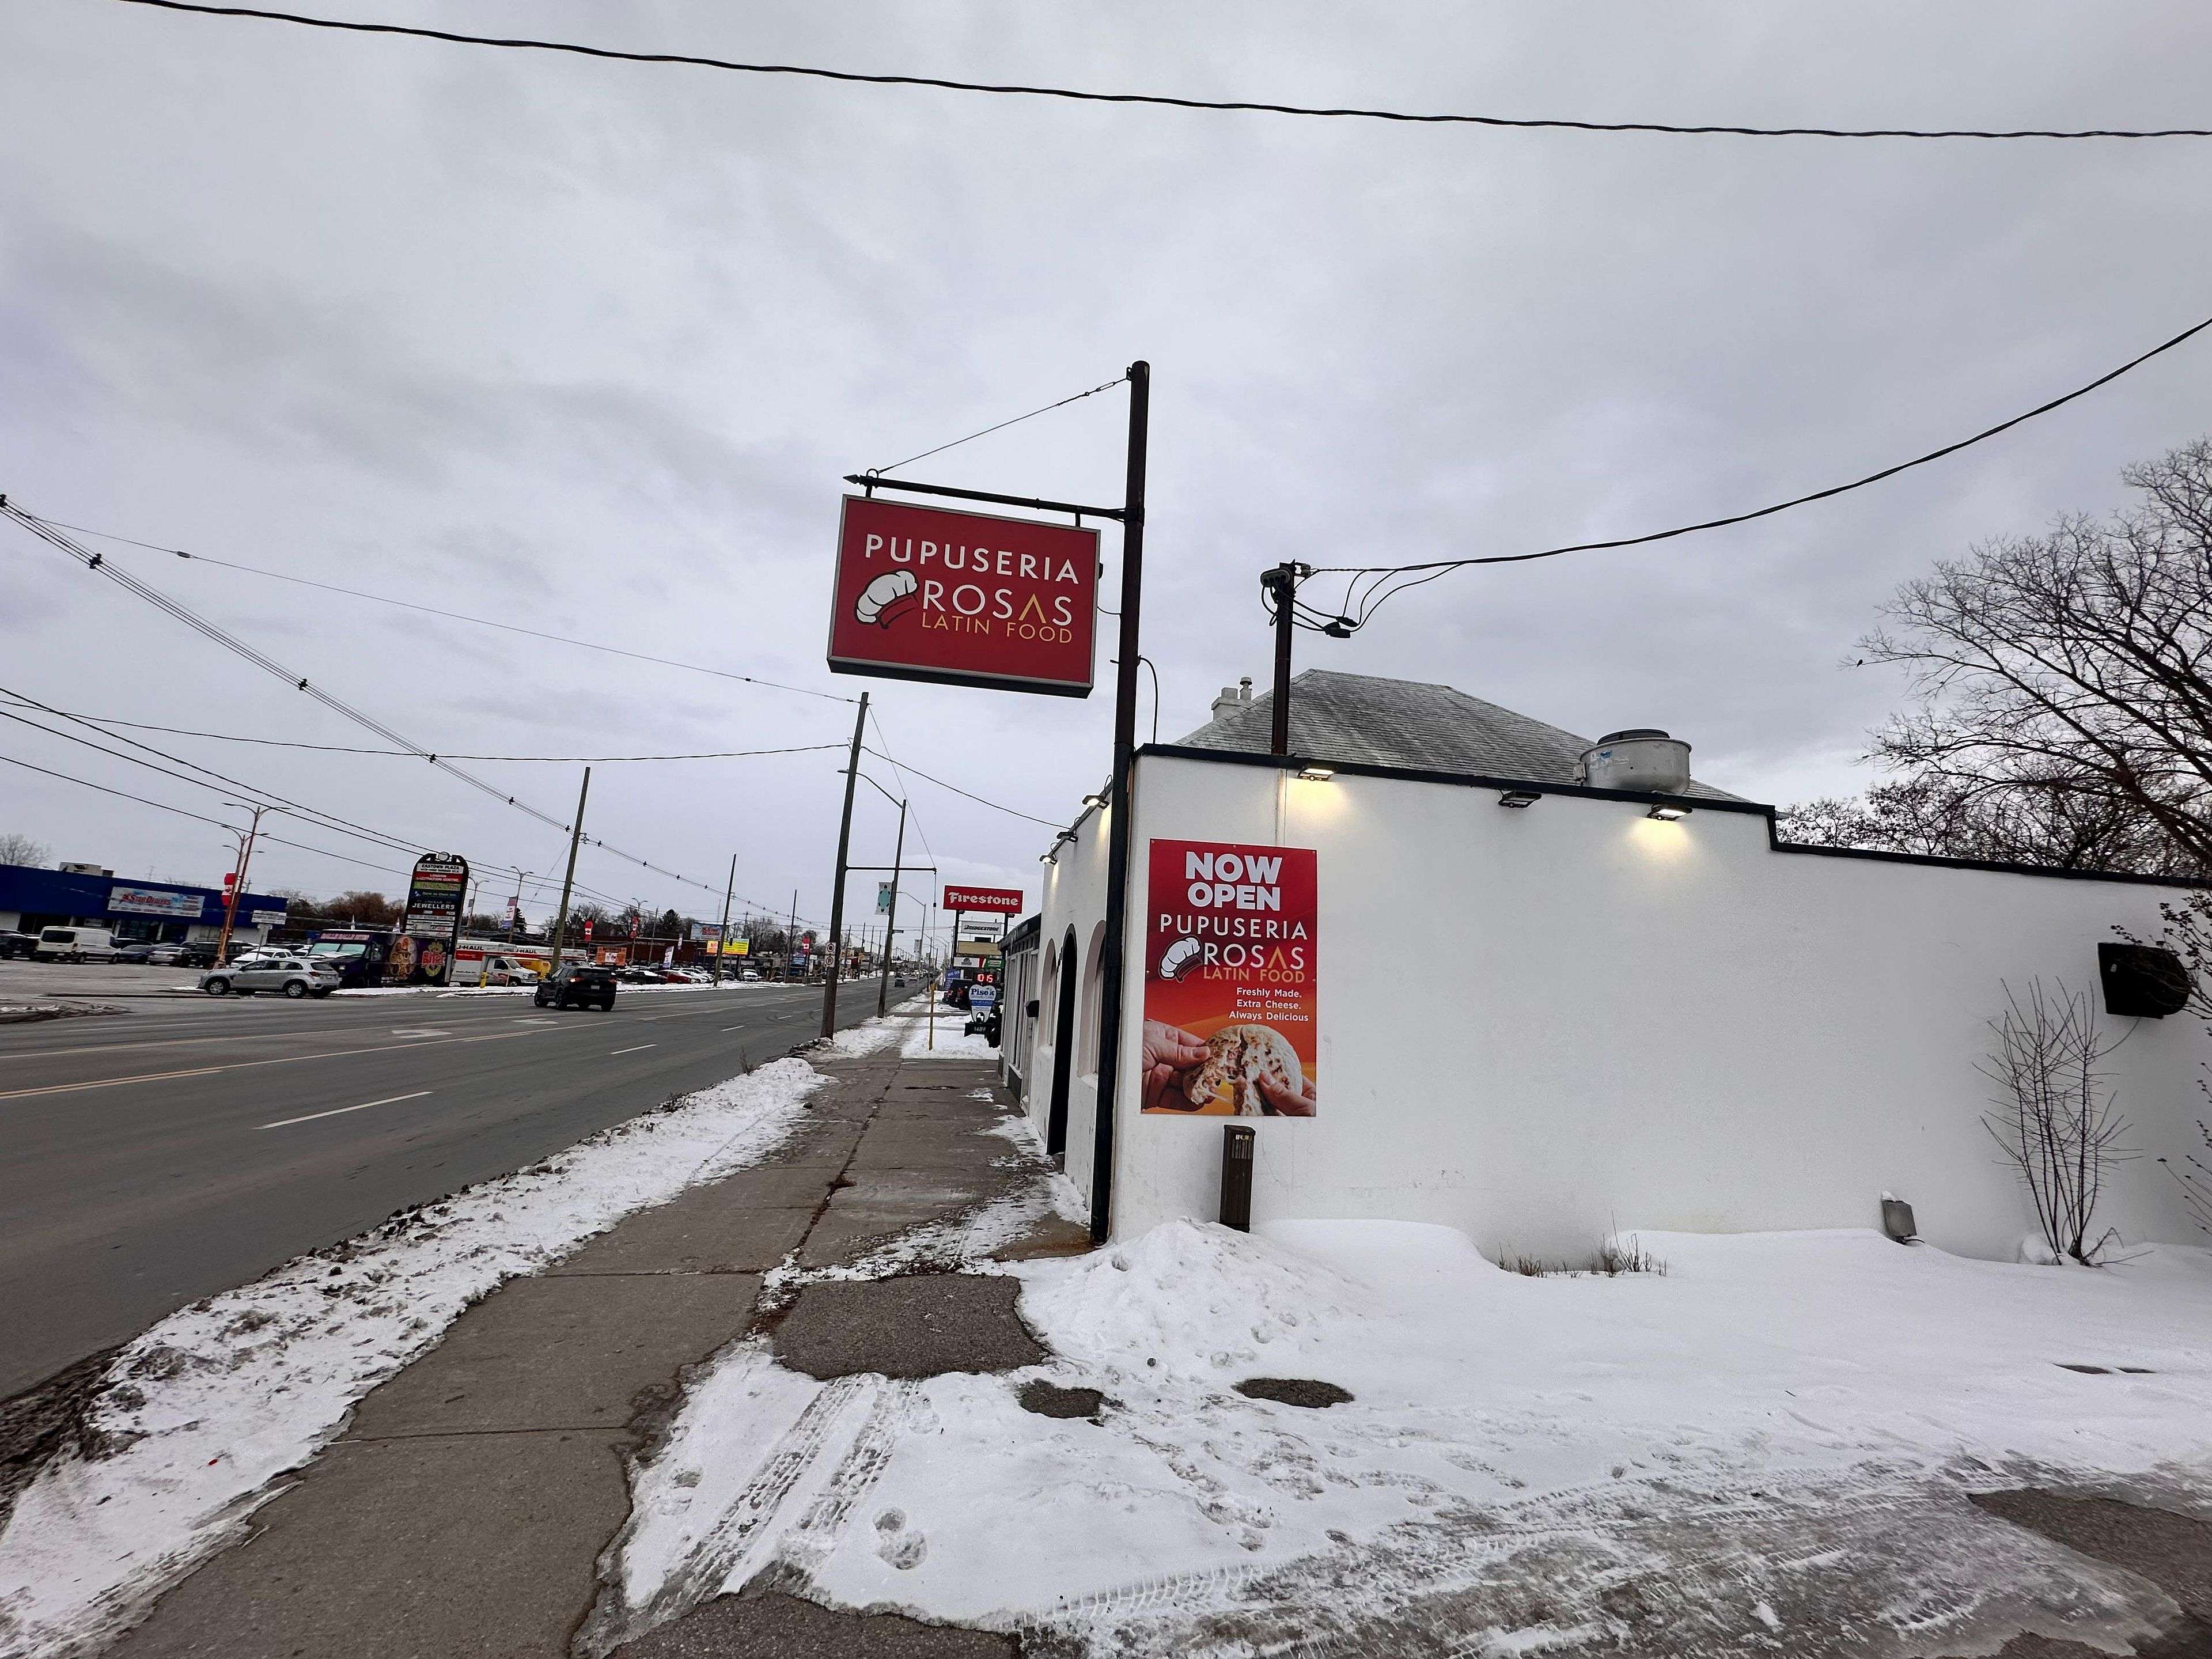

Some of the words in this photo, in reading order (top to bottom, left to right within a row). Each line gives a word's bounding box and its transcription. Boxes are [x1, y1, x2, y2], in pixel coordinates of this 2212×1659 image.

[865, 533, 1078, 584] PUPUSERIA
[922, 612, 990, 634] LATIN
[1006, 622, 1072, 643] FOOD
[1185, 851, 1283, 884] NOW
[948, 892, 1019, 906] Firestone
[1188, 882, 1280, 911] OPEN
[1160, 914, 1308, 940] PUPUSERIA
[1203, 967, 1250, 980] LATIN
[1260, 969, 1305, 983] FOOD
[1236, 987, 1270, 998] Freshly
[1274, 989, 1302, 998] Made.
[1236, 999, 1261, 1008] Extra
[1266, 1000, 1301, 1010] Cheese.
[1229, 1010, 1262, 1021] Always
[1266, 1012, 1309, 1021] Delicious
